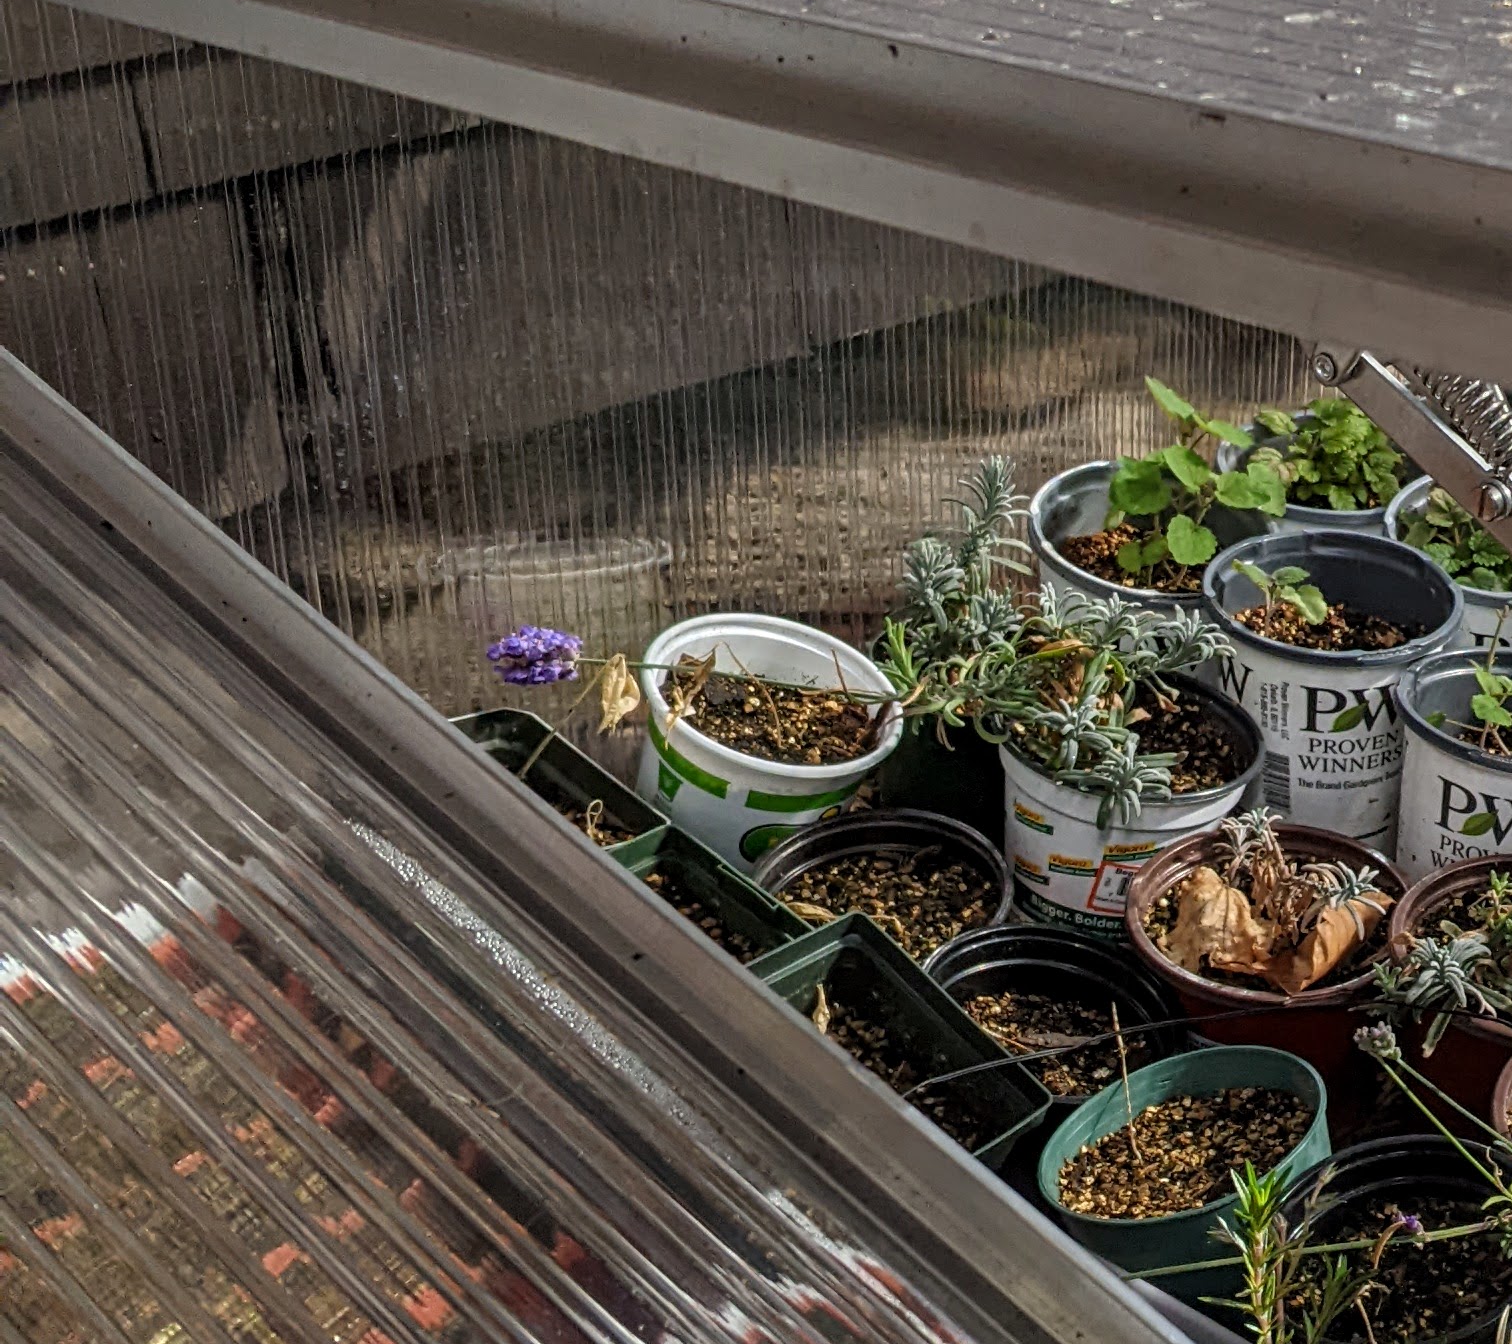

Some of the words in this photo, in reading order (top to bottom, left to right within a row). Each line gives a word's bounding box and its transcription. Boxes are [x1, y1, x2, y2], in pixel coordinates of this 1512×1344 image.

[1220, 655, 1254, 703] W
[1300, 683, 1399, 733] PW
[1308, 730, 1399, 755] PROVEN
[1298, 745, 1402, 774] WINNERS
[1440, 834, 1499, 859] PRO
